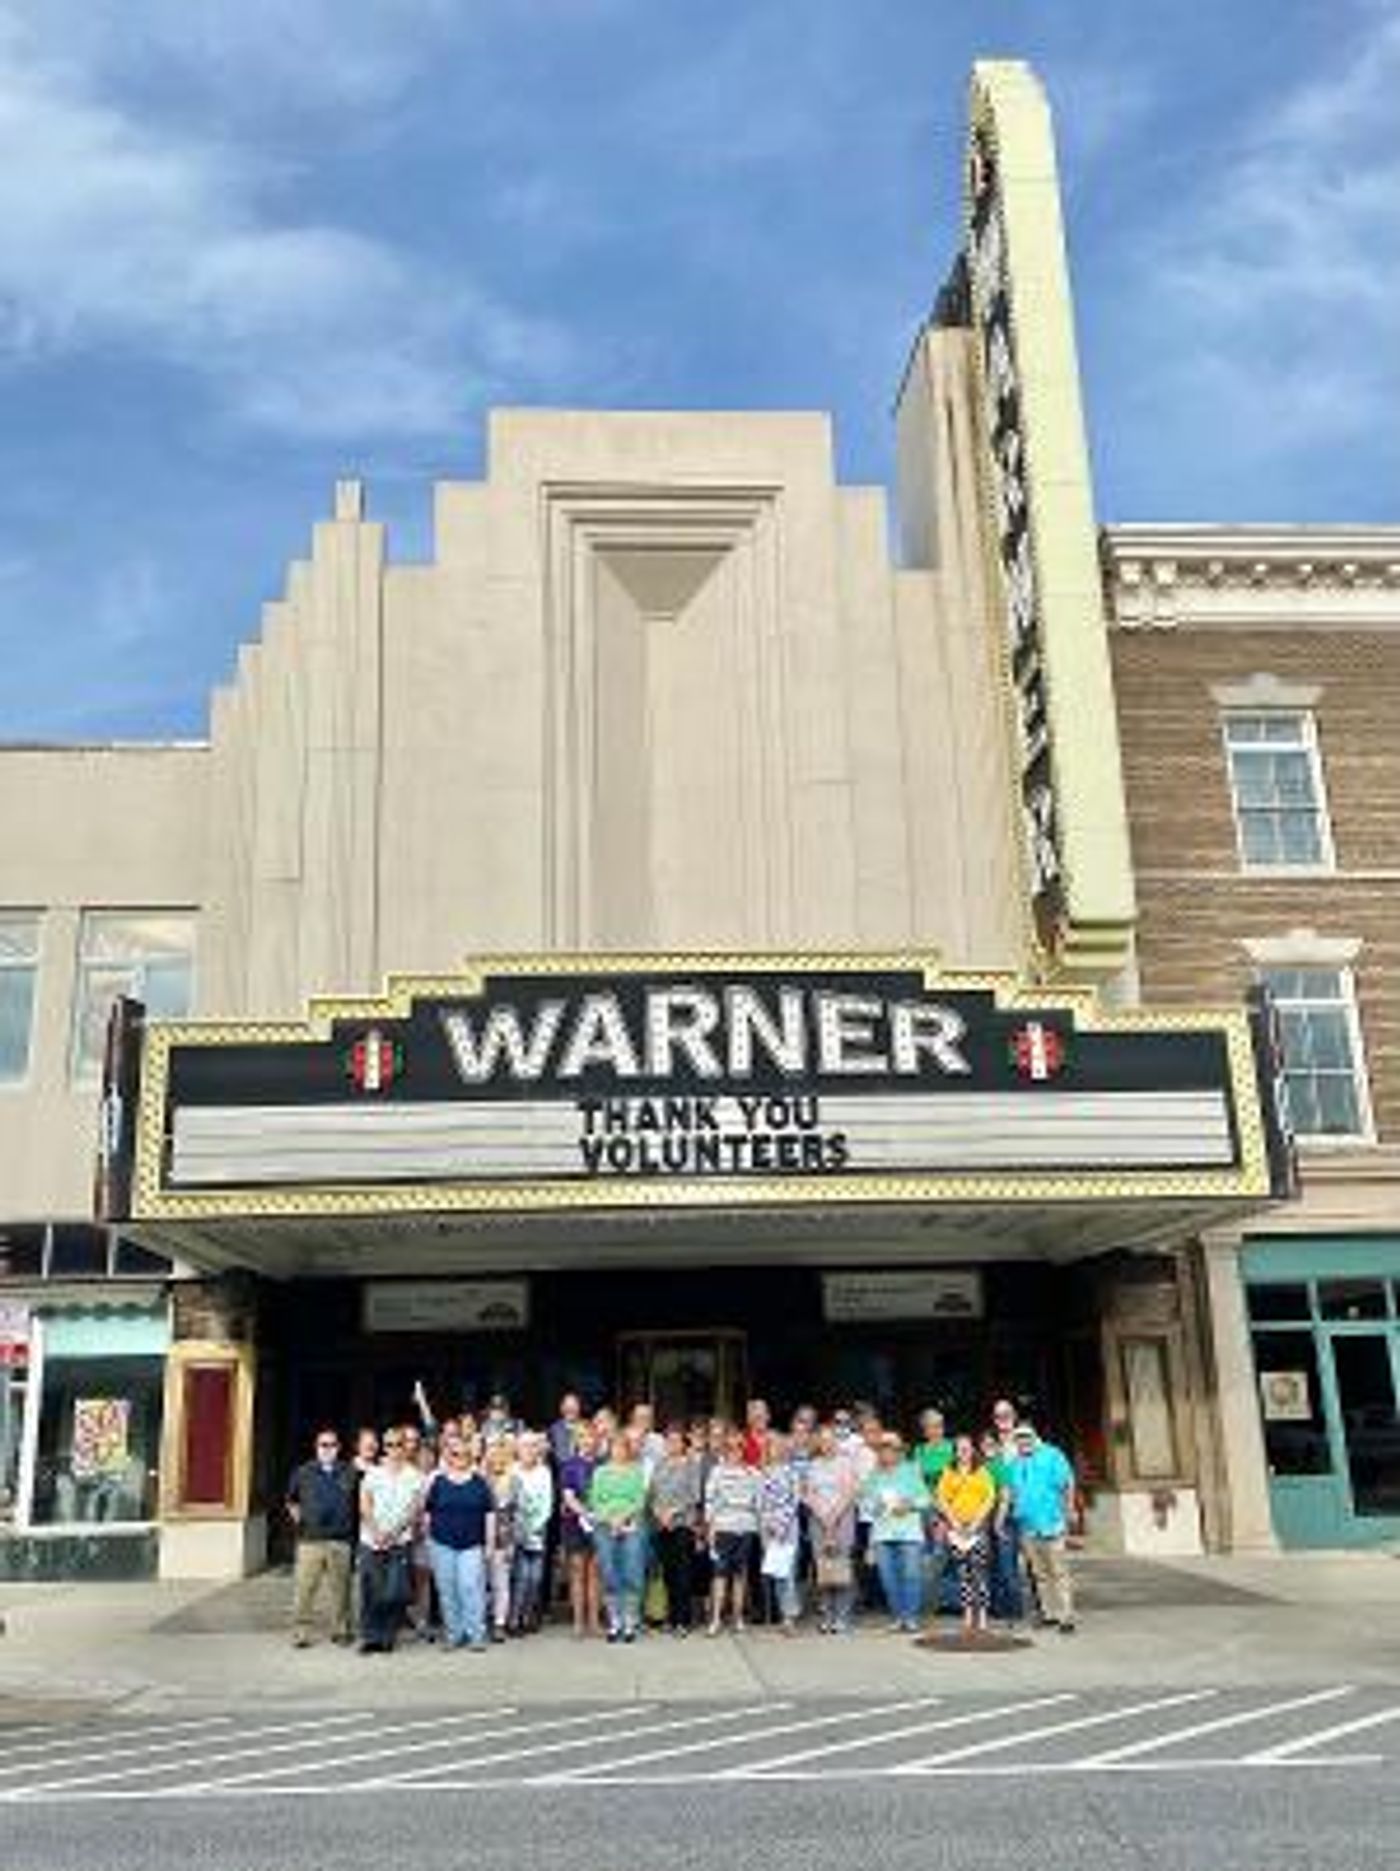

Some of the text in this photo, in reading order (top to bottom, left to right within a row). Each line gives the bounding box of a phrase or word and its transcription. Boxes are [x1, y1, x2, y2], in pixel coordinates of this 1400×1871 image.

[443, 986, 970, 1083] WARNER
[579, 1096, 819, 1134] THANK YOU
[579, 1134, 850, 1171] VOLUNTEERS
